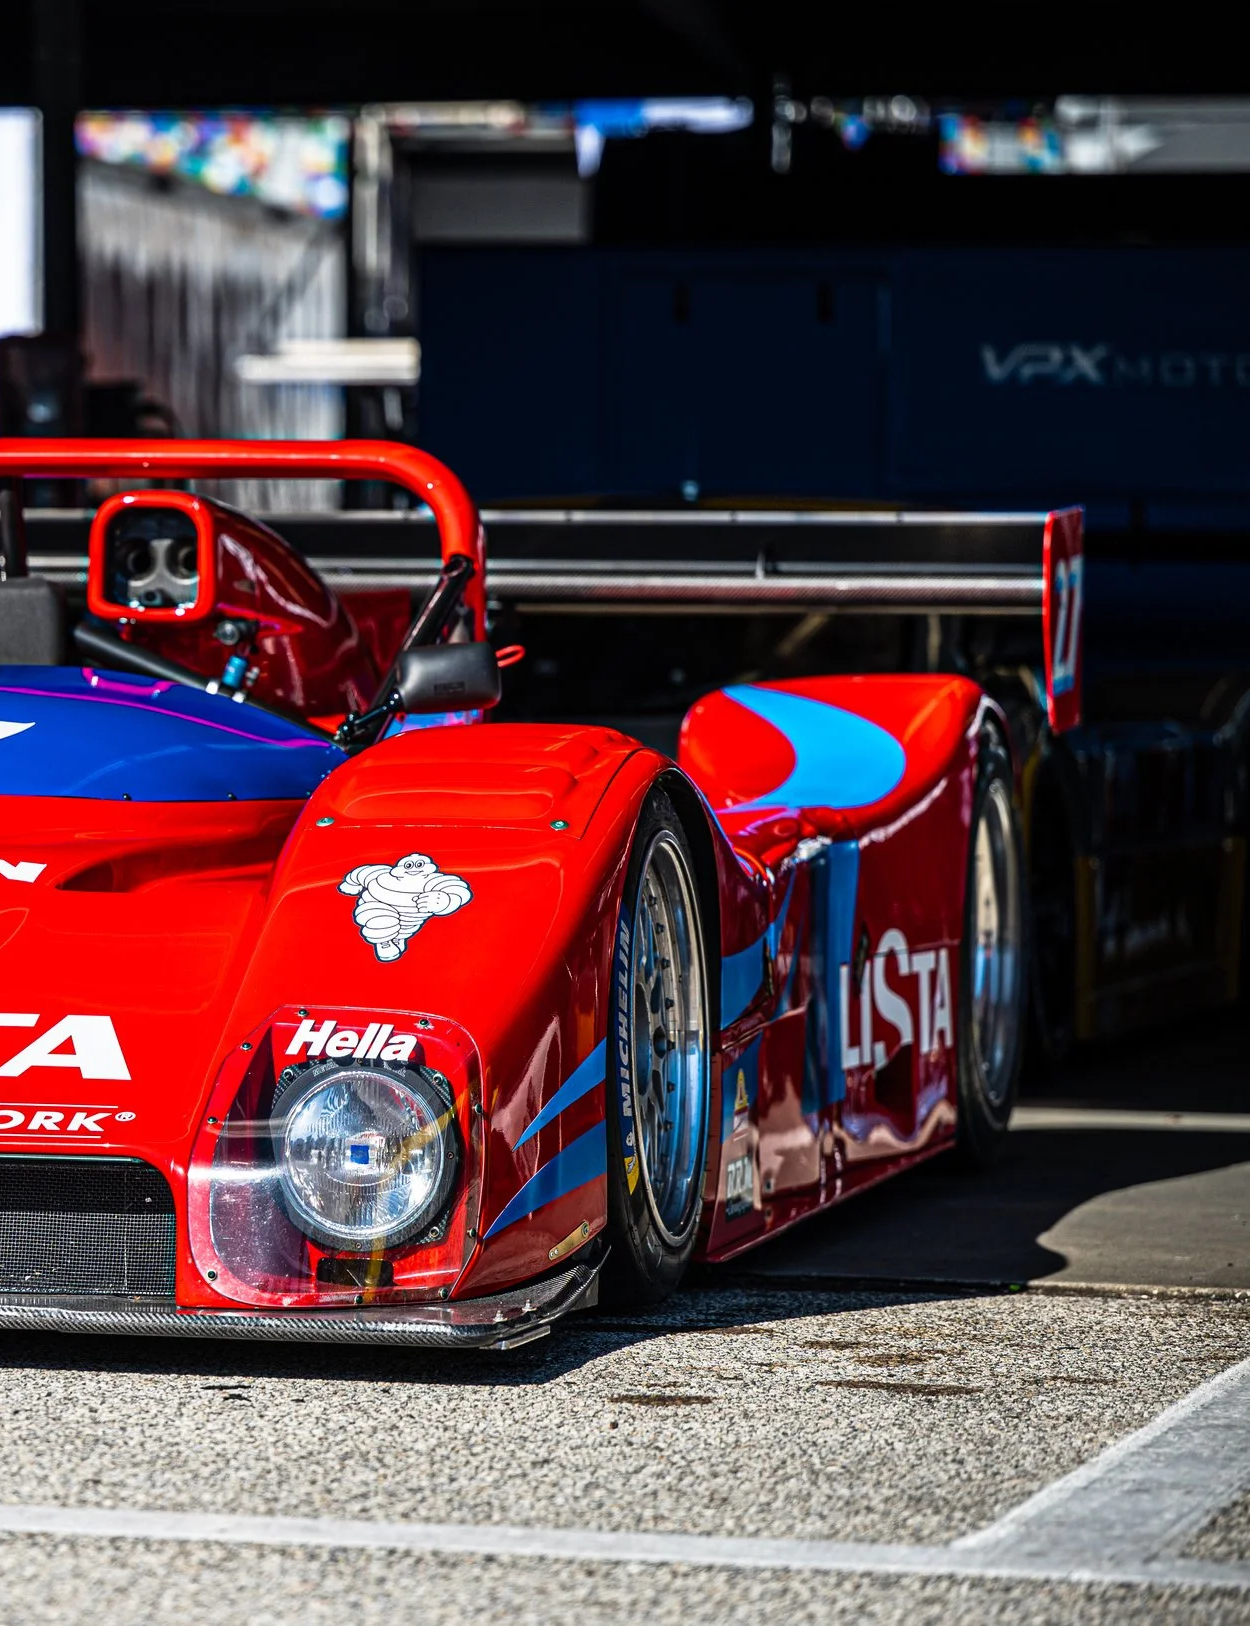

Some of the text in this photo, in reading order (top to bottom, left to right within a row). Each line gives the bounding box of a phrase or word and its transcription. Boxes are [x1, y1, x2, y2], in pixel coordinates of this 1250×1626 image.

[980, 342, 1110, 385] VPX
[285, 1019, 418, 1063] Hella
[616, 919, 633, 1118] MICHELIN
[839, 927, 953, 1071] LISTA
